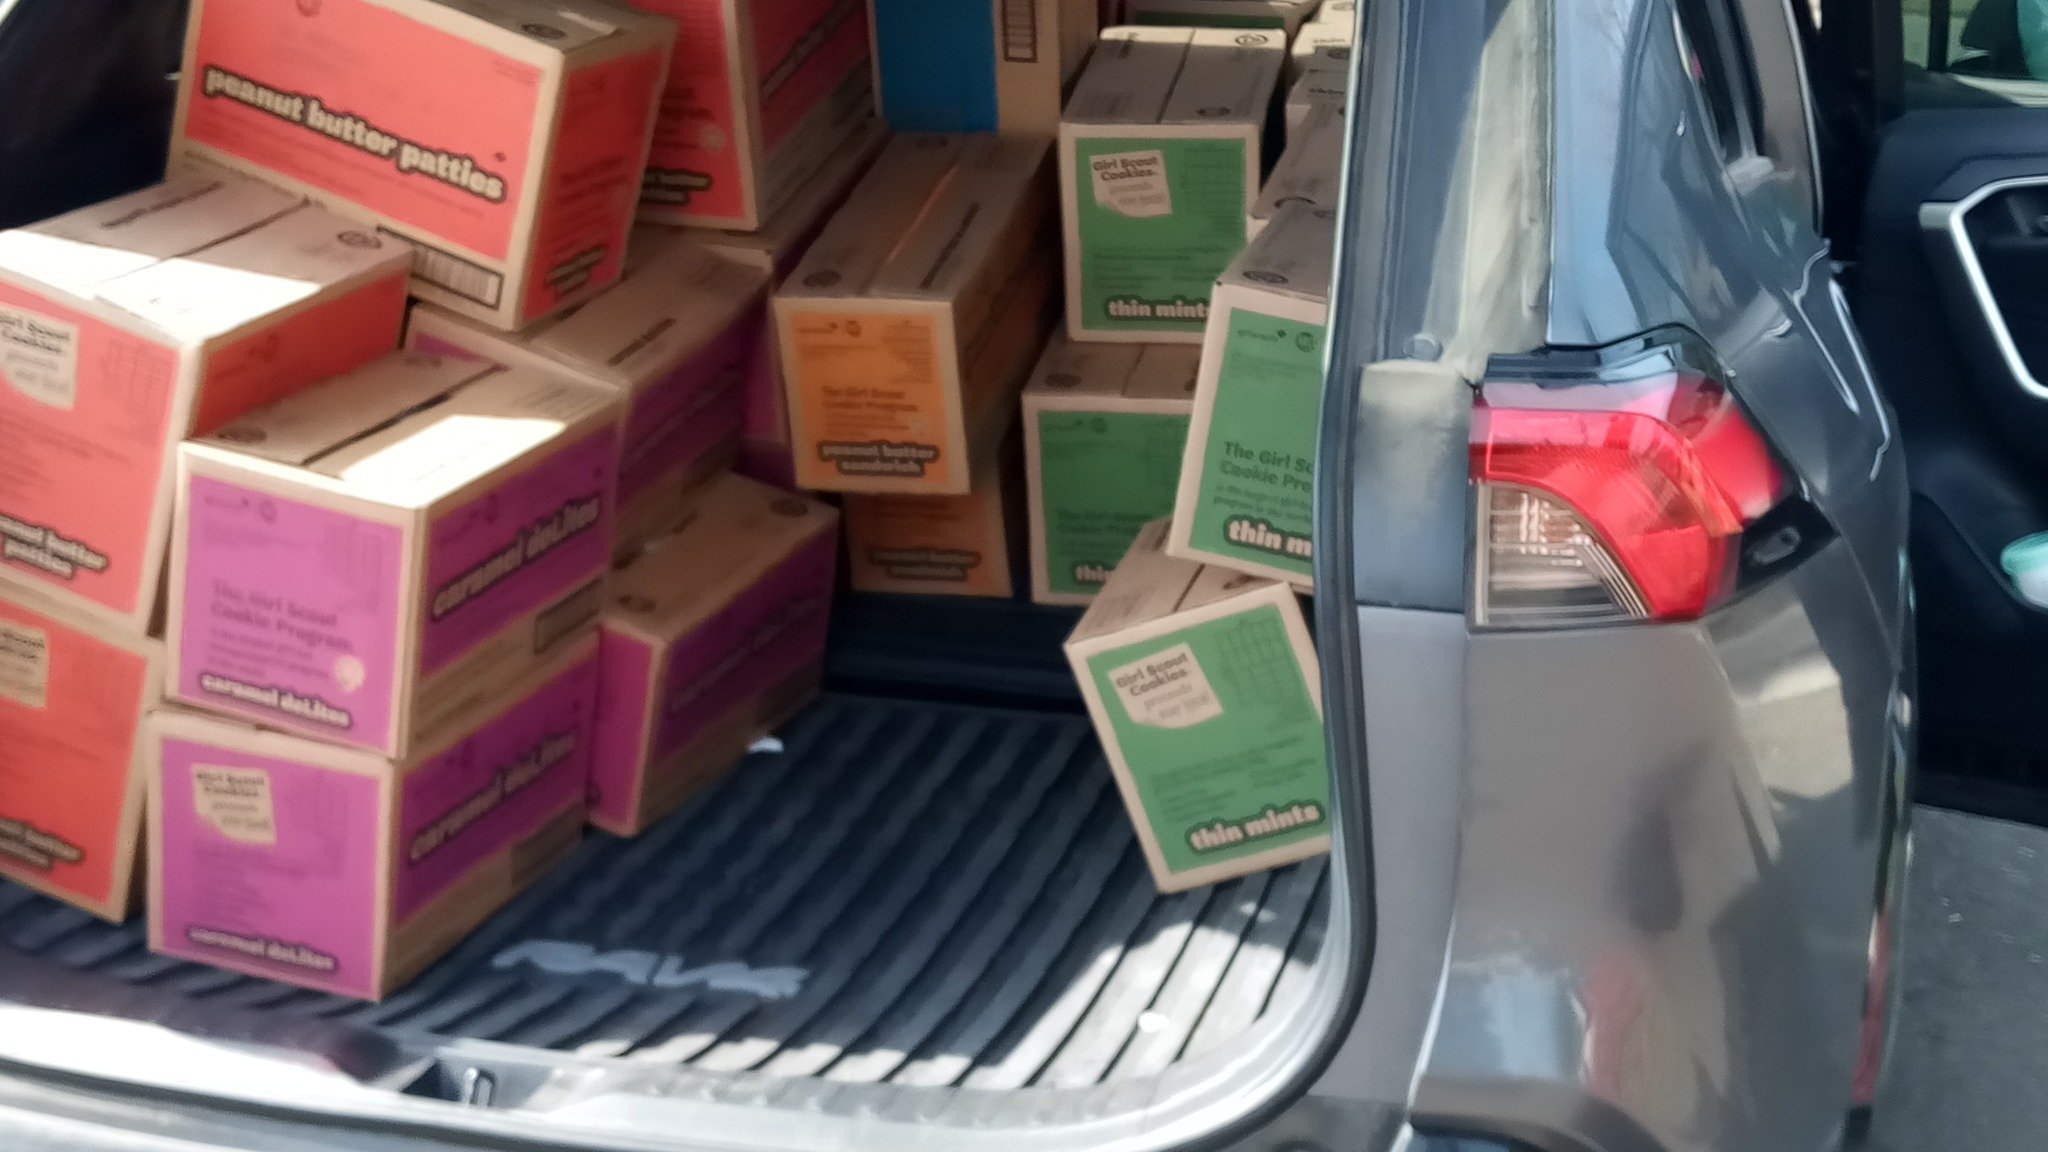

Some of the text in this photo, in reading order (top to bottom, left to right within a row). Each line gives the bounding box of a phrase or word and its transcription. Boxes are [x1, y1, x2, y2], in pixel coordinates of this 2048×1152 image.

[203, 66, 506, 202] peanut butter patties
[1093, 156, 1159, 172] Girl Scout
[1107, 298, 1151, 319] thin
[1225, 441, 1254, 460] The
[1259, 450, 1291, 469] Girl
[1220, 460, 1278, 485] Cookie
[1226, 517, 1284, 551] thin
[1116, 651, 1188, 688] Girl Scout
[1189, 803, 1323, 852] thin mints
